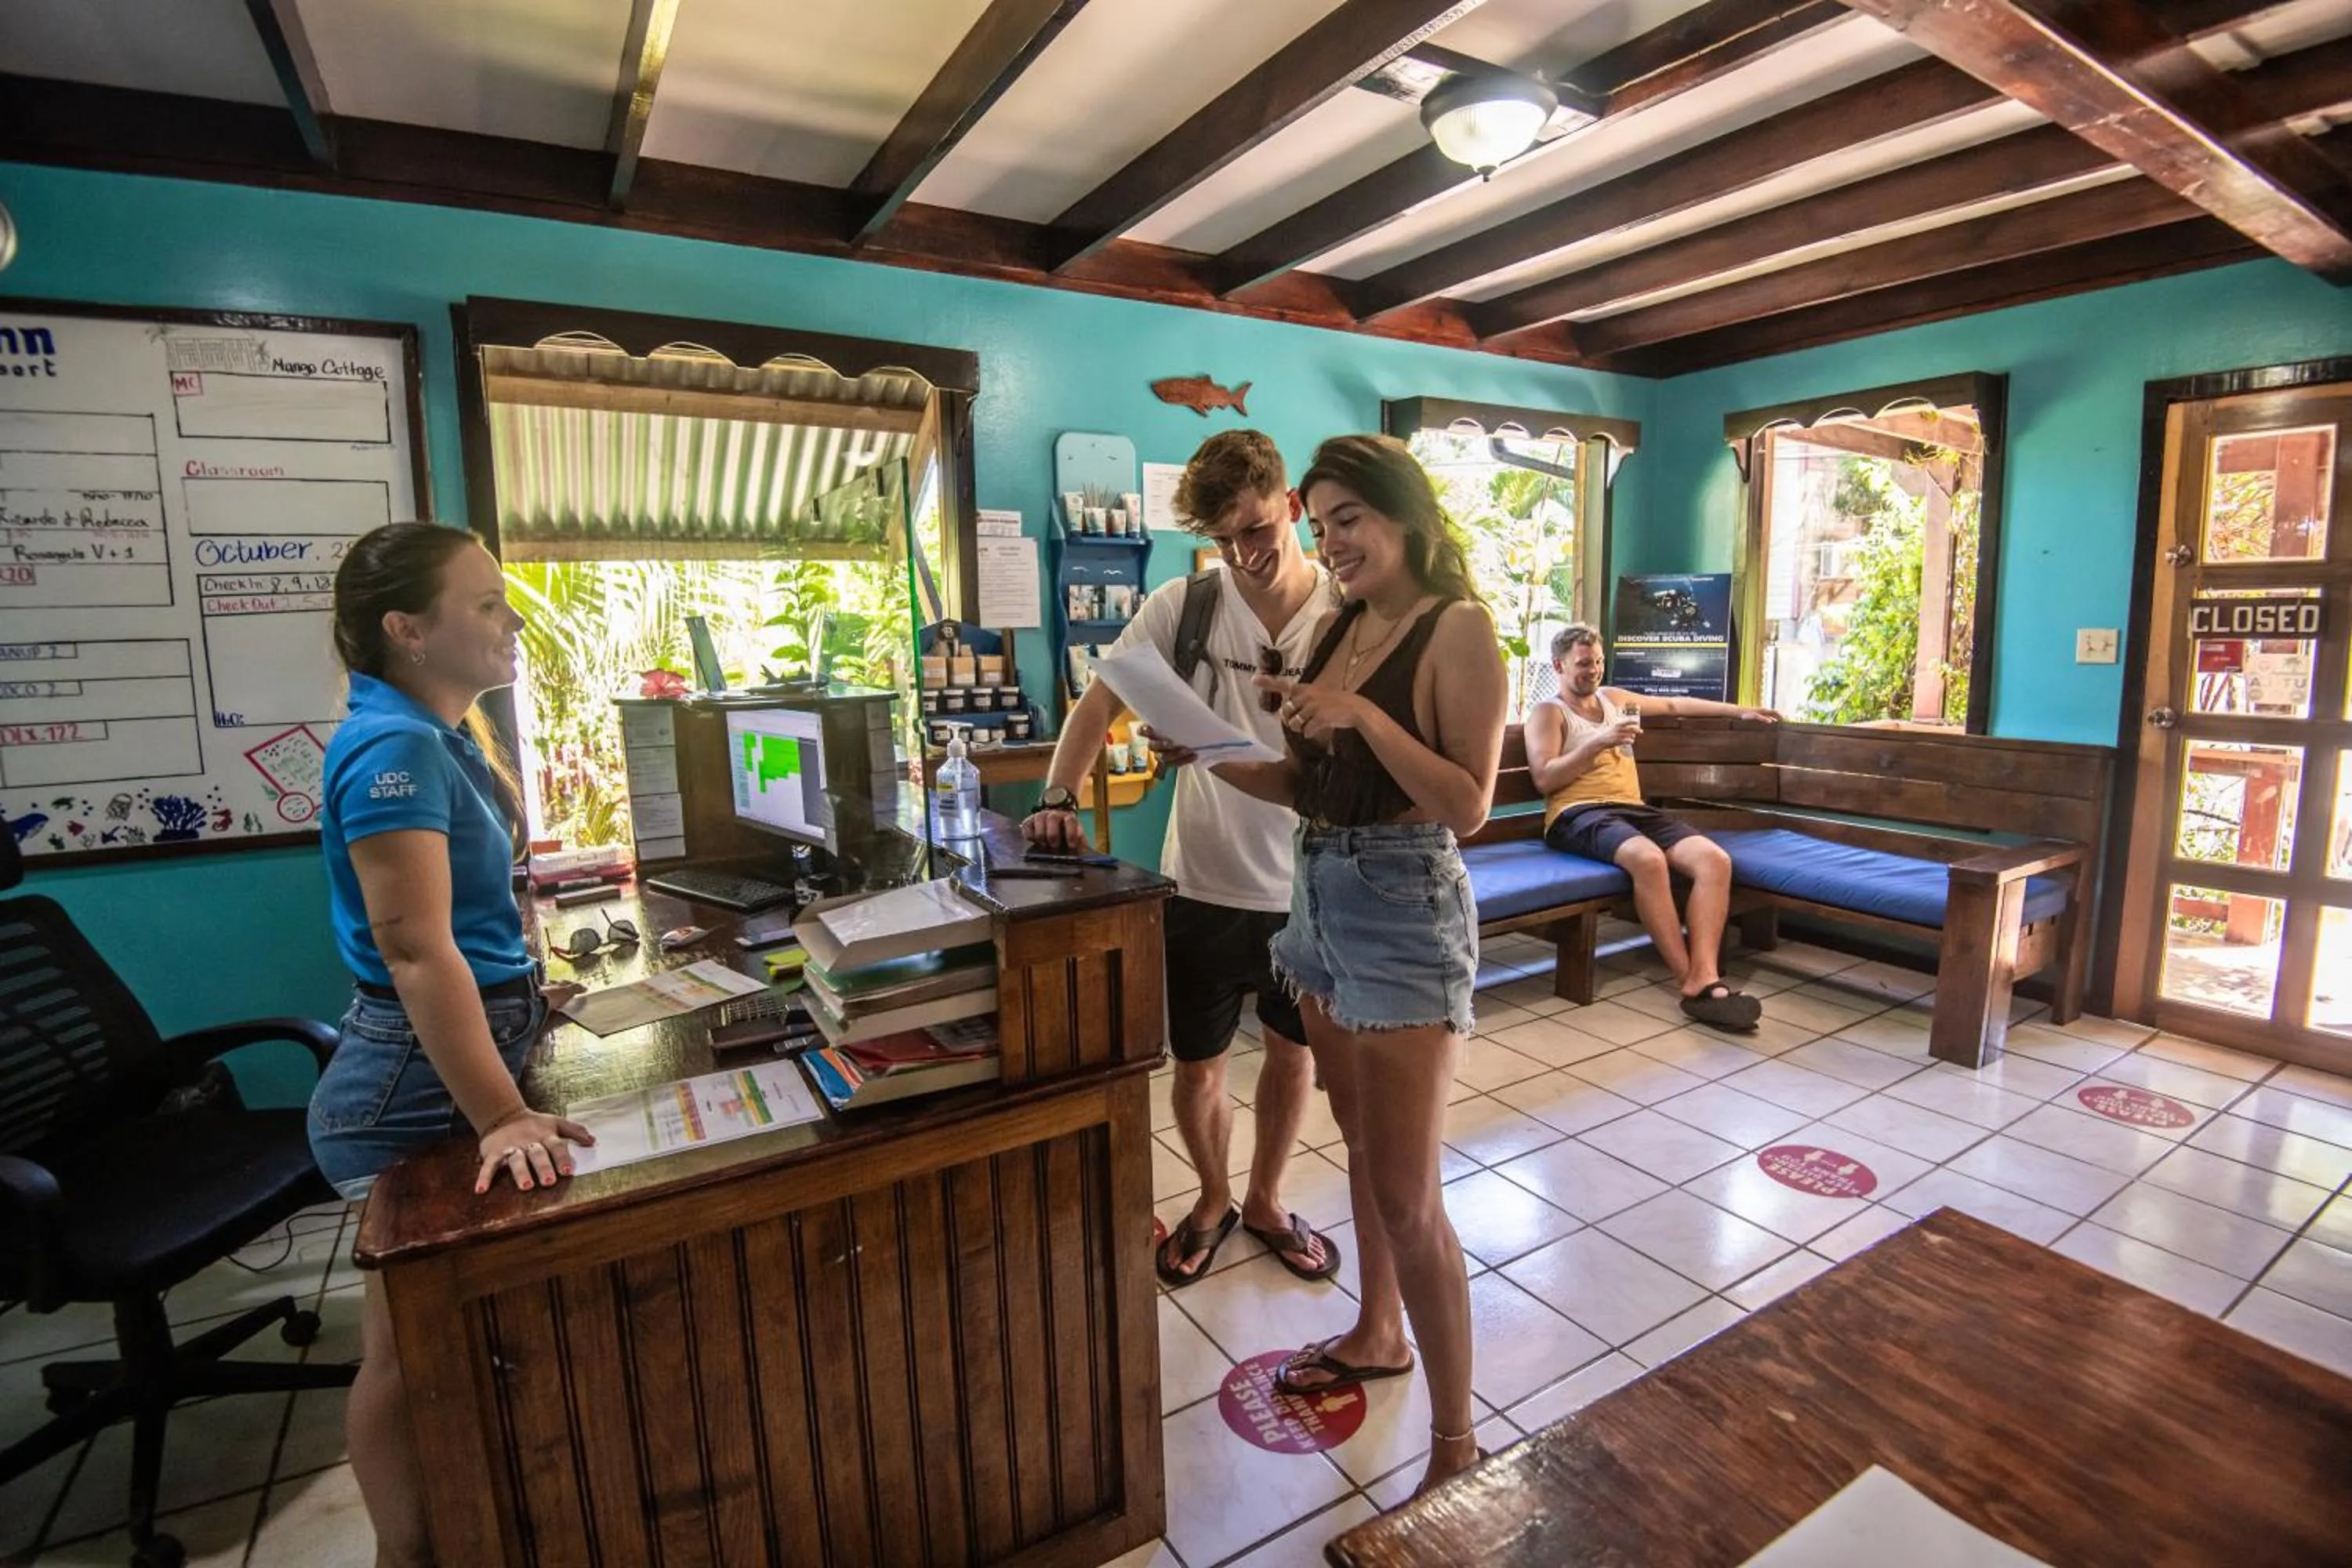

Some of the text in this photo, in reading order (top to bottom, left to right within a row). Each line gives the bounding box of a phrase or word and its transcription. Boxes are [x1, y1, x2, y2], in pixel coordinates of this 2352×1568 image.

[272, 358, 385, 379] Mango Cottage
[79, 506, 150, 528] Rebecca
[91, 543, 104, 560] V
[207, 599, 250, 612] Check
[252, 598, 276, 612] Out
[2192, 604, 2320, 633] CLOSED
[1224, 659, 1305, 677] TOMMY JEA
[375, 771, 411, 784] UDC
[368, 784, 419, 798] STAFF
[1229, 1380, 1288, 1444] PLEASE
[1283, 1417, 1316, 1449] KEEP
